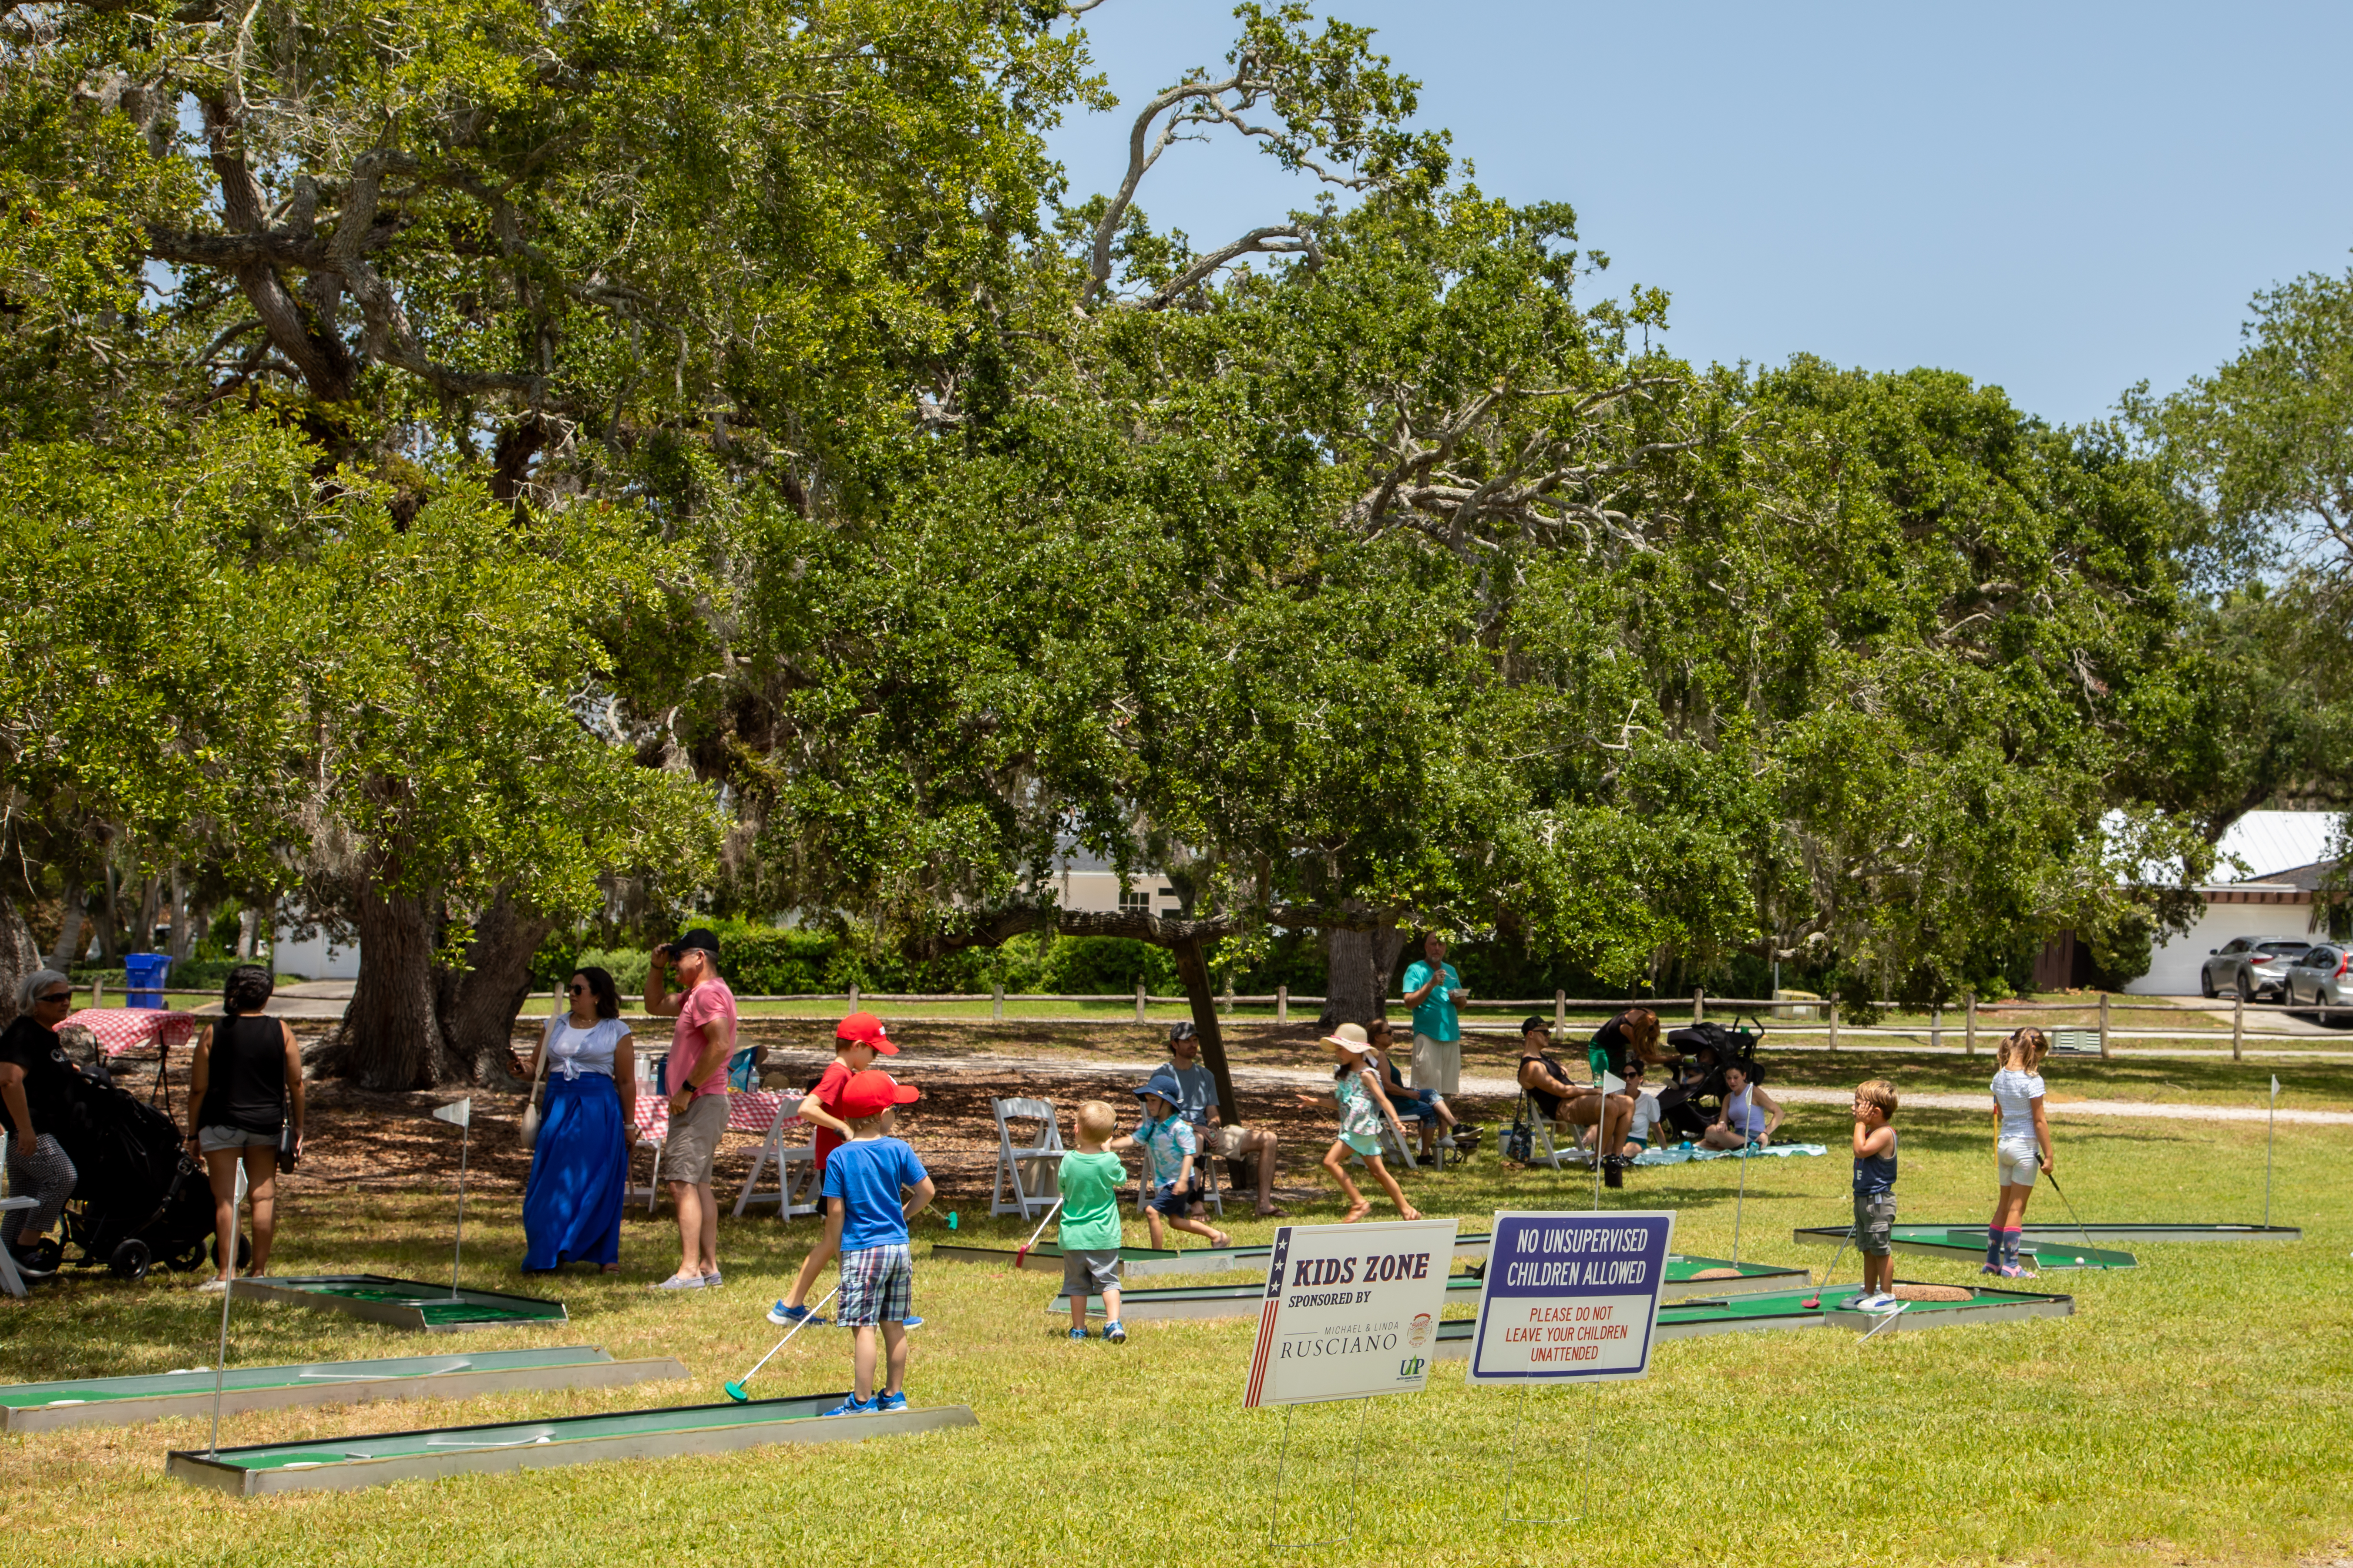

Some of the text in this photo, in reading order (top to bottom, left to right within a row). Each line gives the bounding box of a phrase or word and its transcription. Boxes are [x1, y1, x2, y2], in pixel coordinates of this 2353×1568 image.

[1516, 1229, 1648, 1253] NO UNSUPERVISED
[1292, 1252, 1430, 1287] KIDS ZONE
[1507, 1261, 1646, 1286] CHILDREN ALLOWED
[1288, 1291, 1371, 1308] SPONSORED BY
[1529, 1306, 1613, 1322] PLEASE DO NOT
[1324, 1321, 1398, 1335] MICHAEL & LINDA
[1506, 1325, 1628, 1342] LEAVE YOUR CHILDREN
[1280, 1333, 1397, 1358] RUSCIANO
[1531, 1346, 1598, 1362] UNATTENDED
[1400, 1358, 1425, 1375] UP
